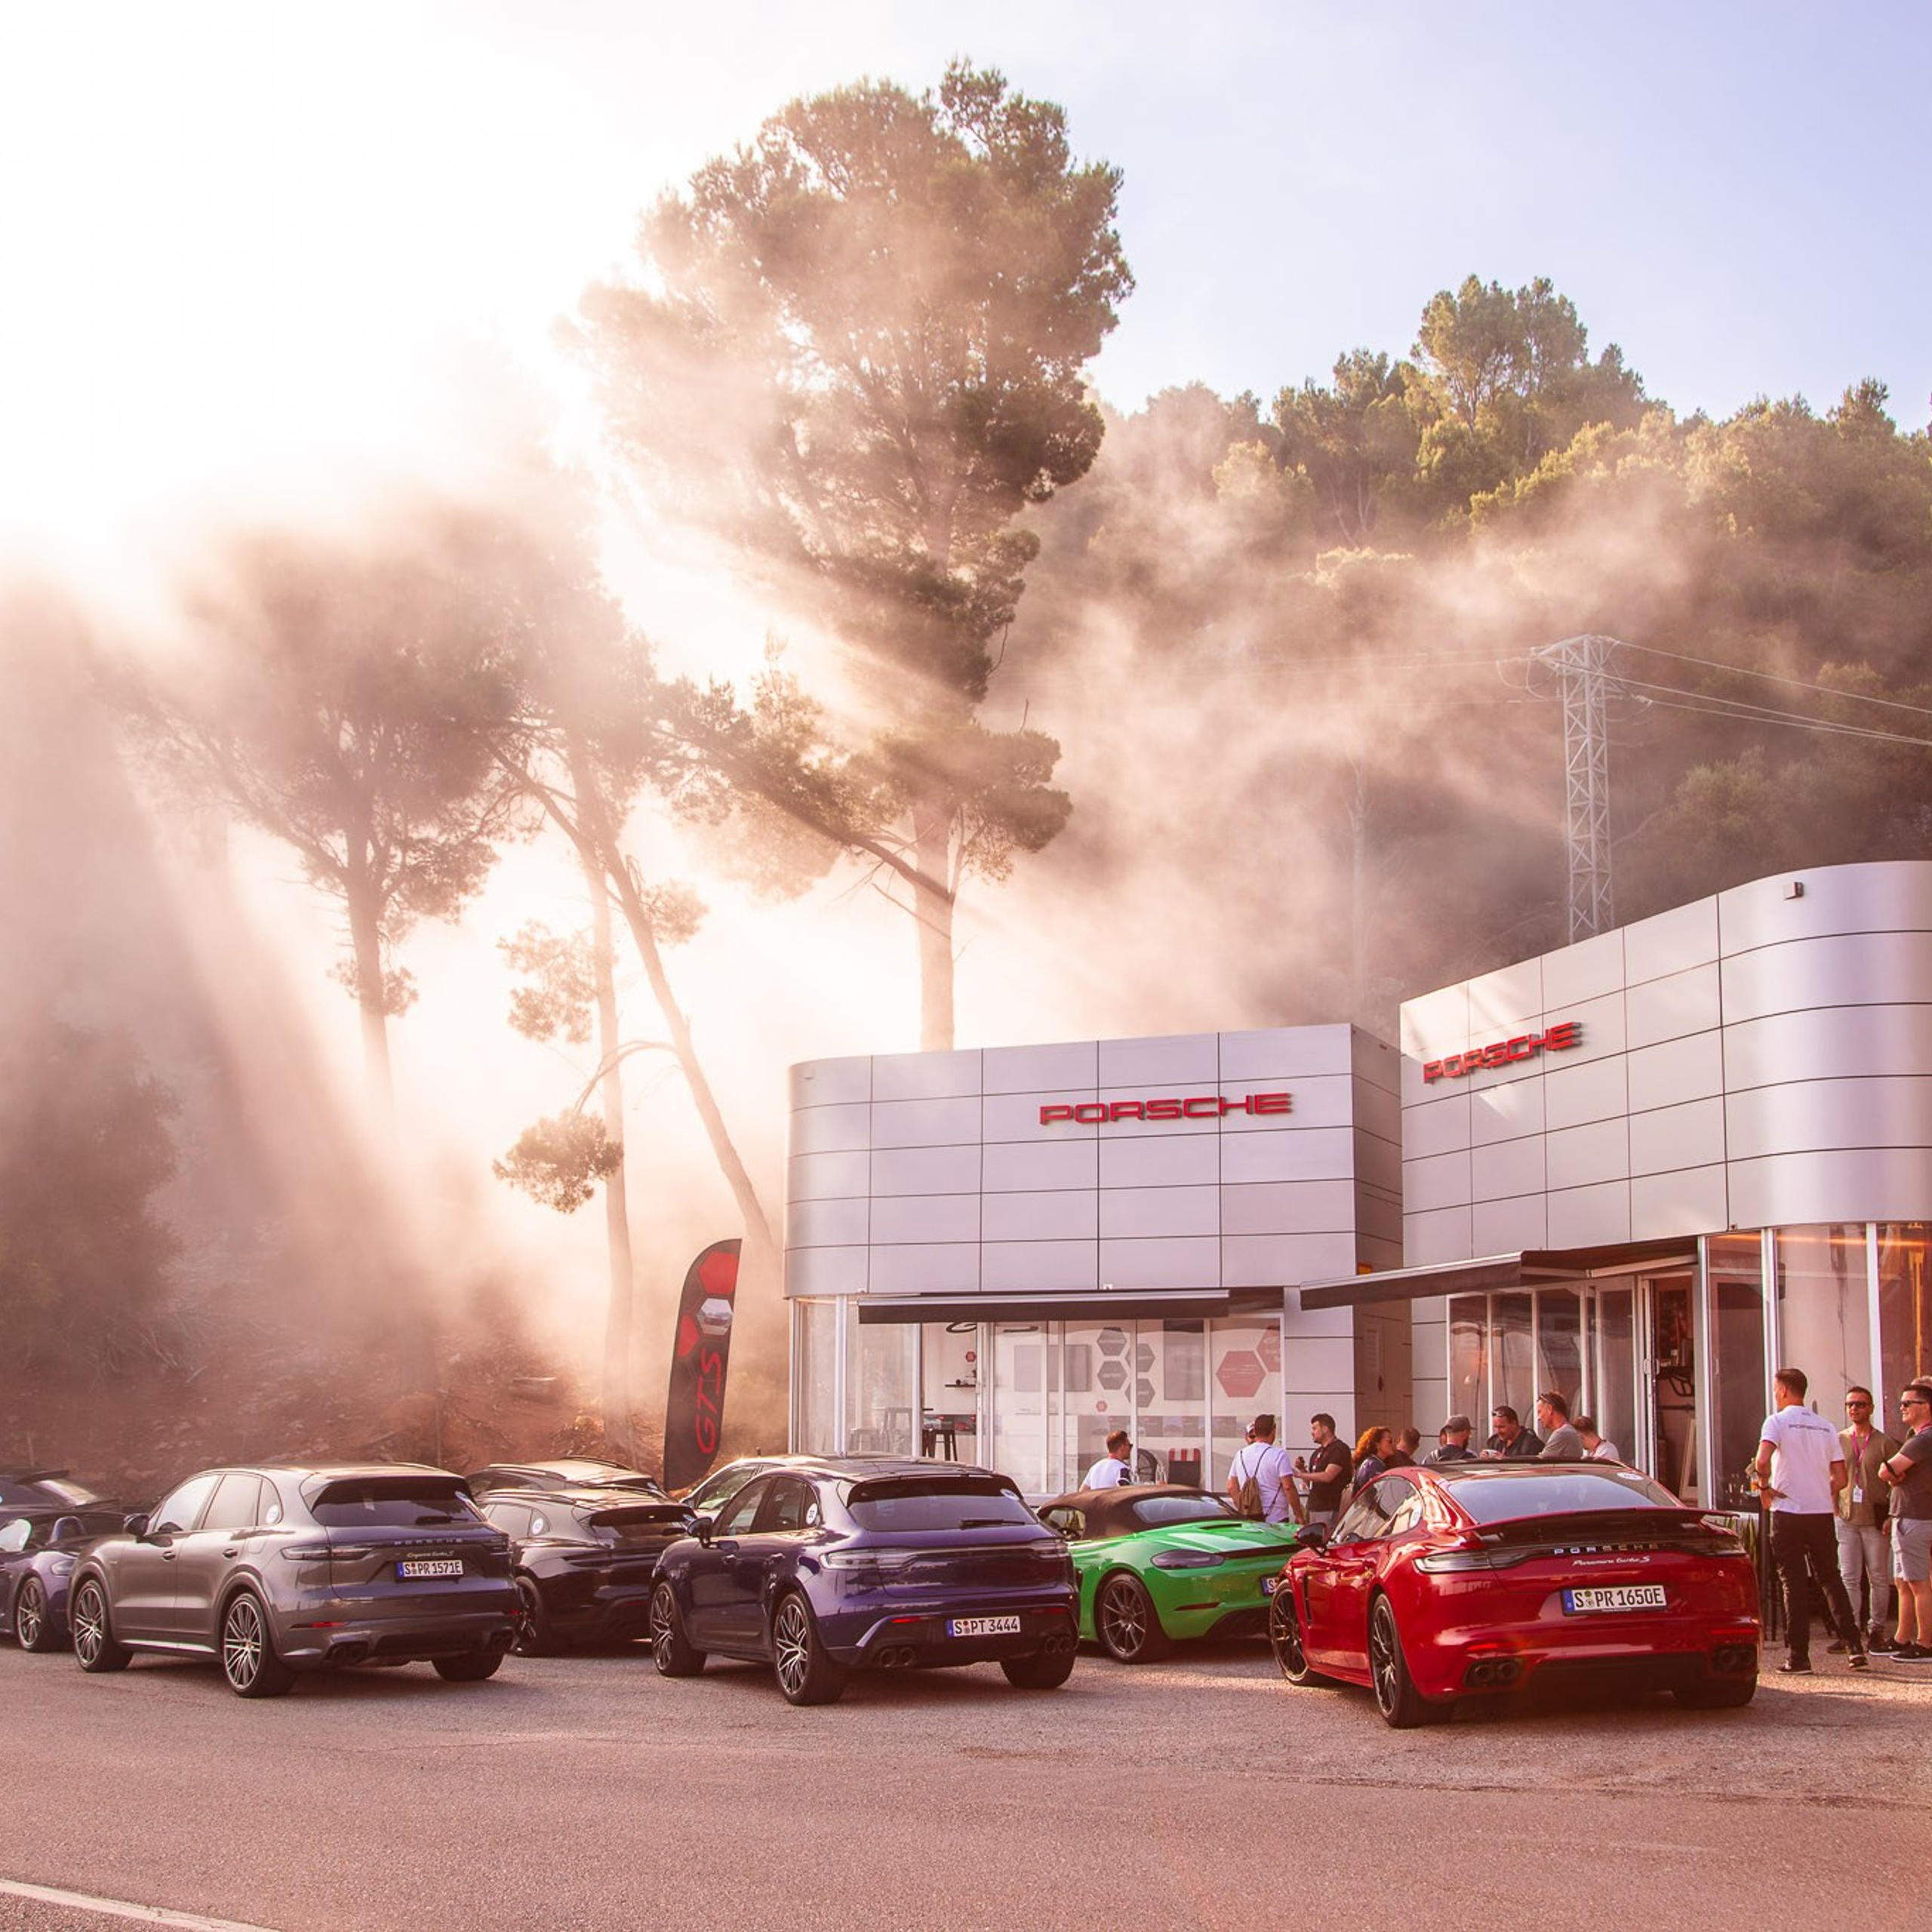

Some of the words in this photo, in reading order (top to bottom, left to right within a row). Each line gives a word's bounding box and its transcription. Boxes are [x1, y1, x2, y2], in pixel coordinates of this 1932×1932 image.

[1423, 1022, 1583, 1084] PORSCHE
[1040, 1093, 1293, 1125] PORSCHE
[695, 1346, 721, 1454] GTS
[1554, 1543, 1659, 1555] PORSCHE
[405, 1563, 411, 1575] S
[417, 1562, 430, 1575] PR
[432, 1561, 462, 1574] 1571E
[1571, 1558, 1614, 1567] Panamera
[1574, 1592, 1584, 1608] S
[1595, 1590, 1615, 1607] PR
[1617, 1588, 1664, 1607] 1650E
[954, 1620, 962, 1635] S
[970, 1620, 986, 1633] PT
[988, 1617, 1018, 1633] 3444
